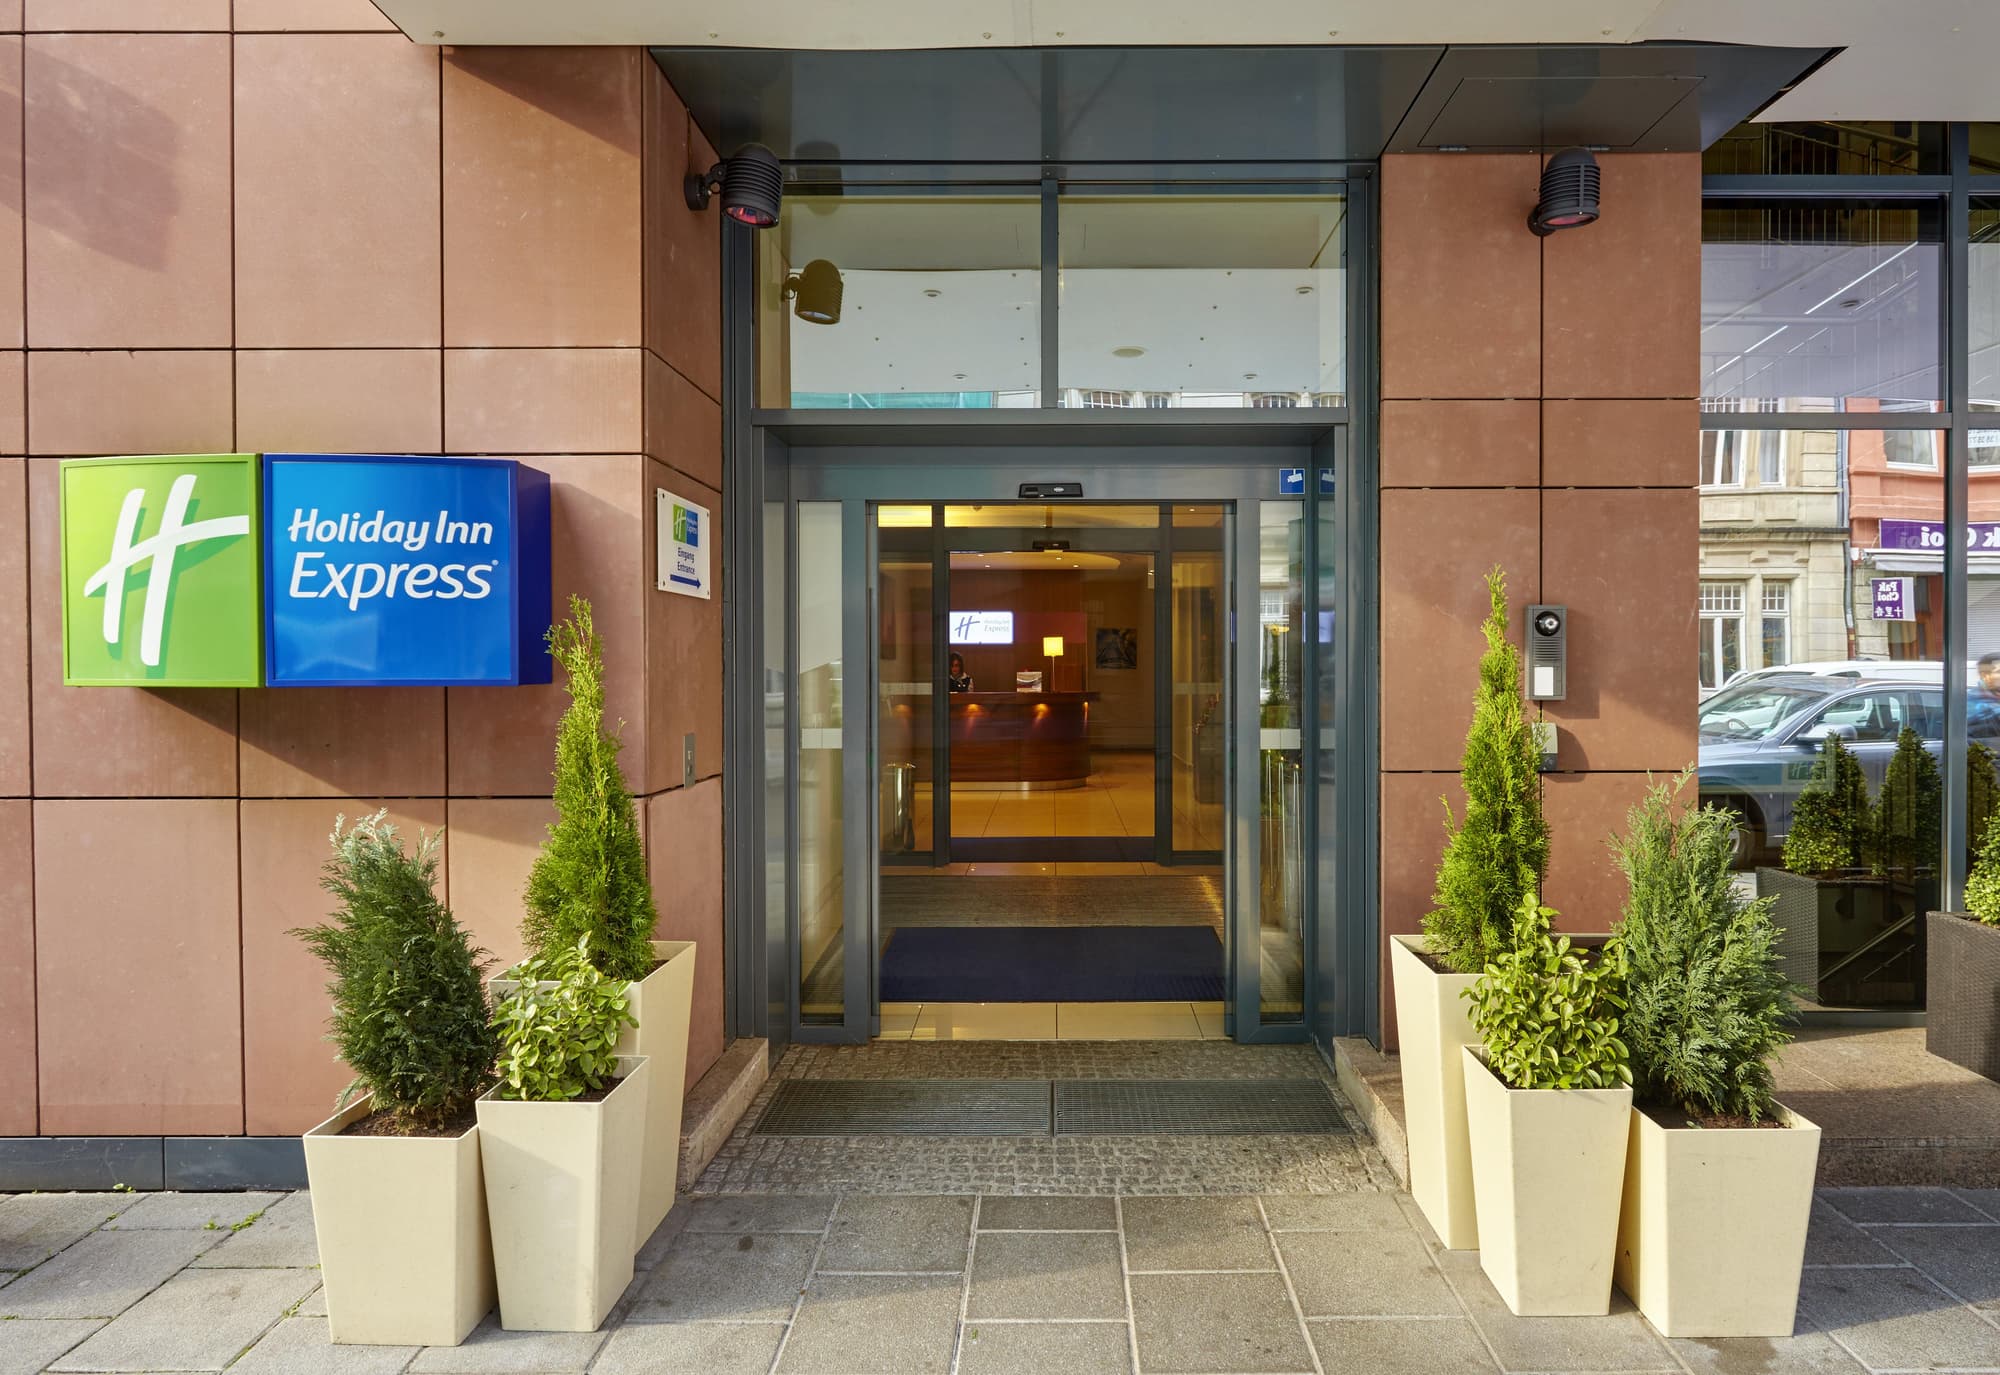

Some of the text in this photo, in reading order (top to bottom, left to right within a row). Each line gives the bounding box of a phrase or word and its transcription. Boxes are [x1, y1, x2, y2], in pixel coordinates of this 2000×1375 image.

[287, 508, 494, 551] Holiday Inn
[84, 474, 249, 666] H
[289, 551, 494, 612] Express
